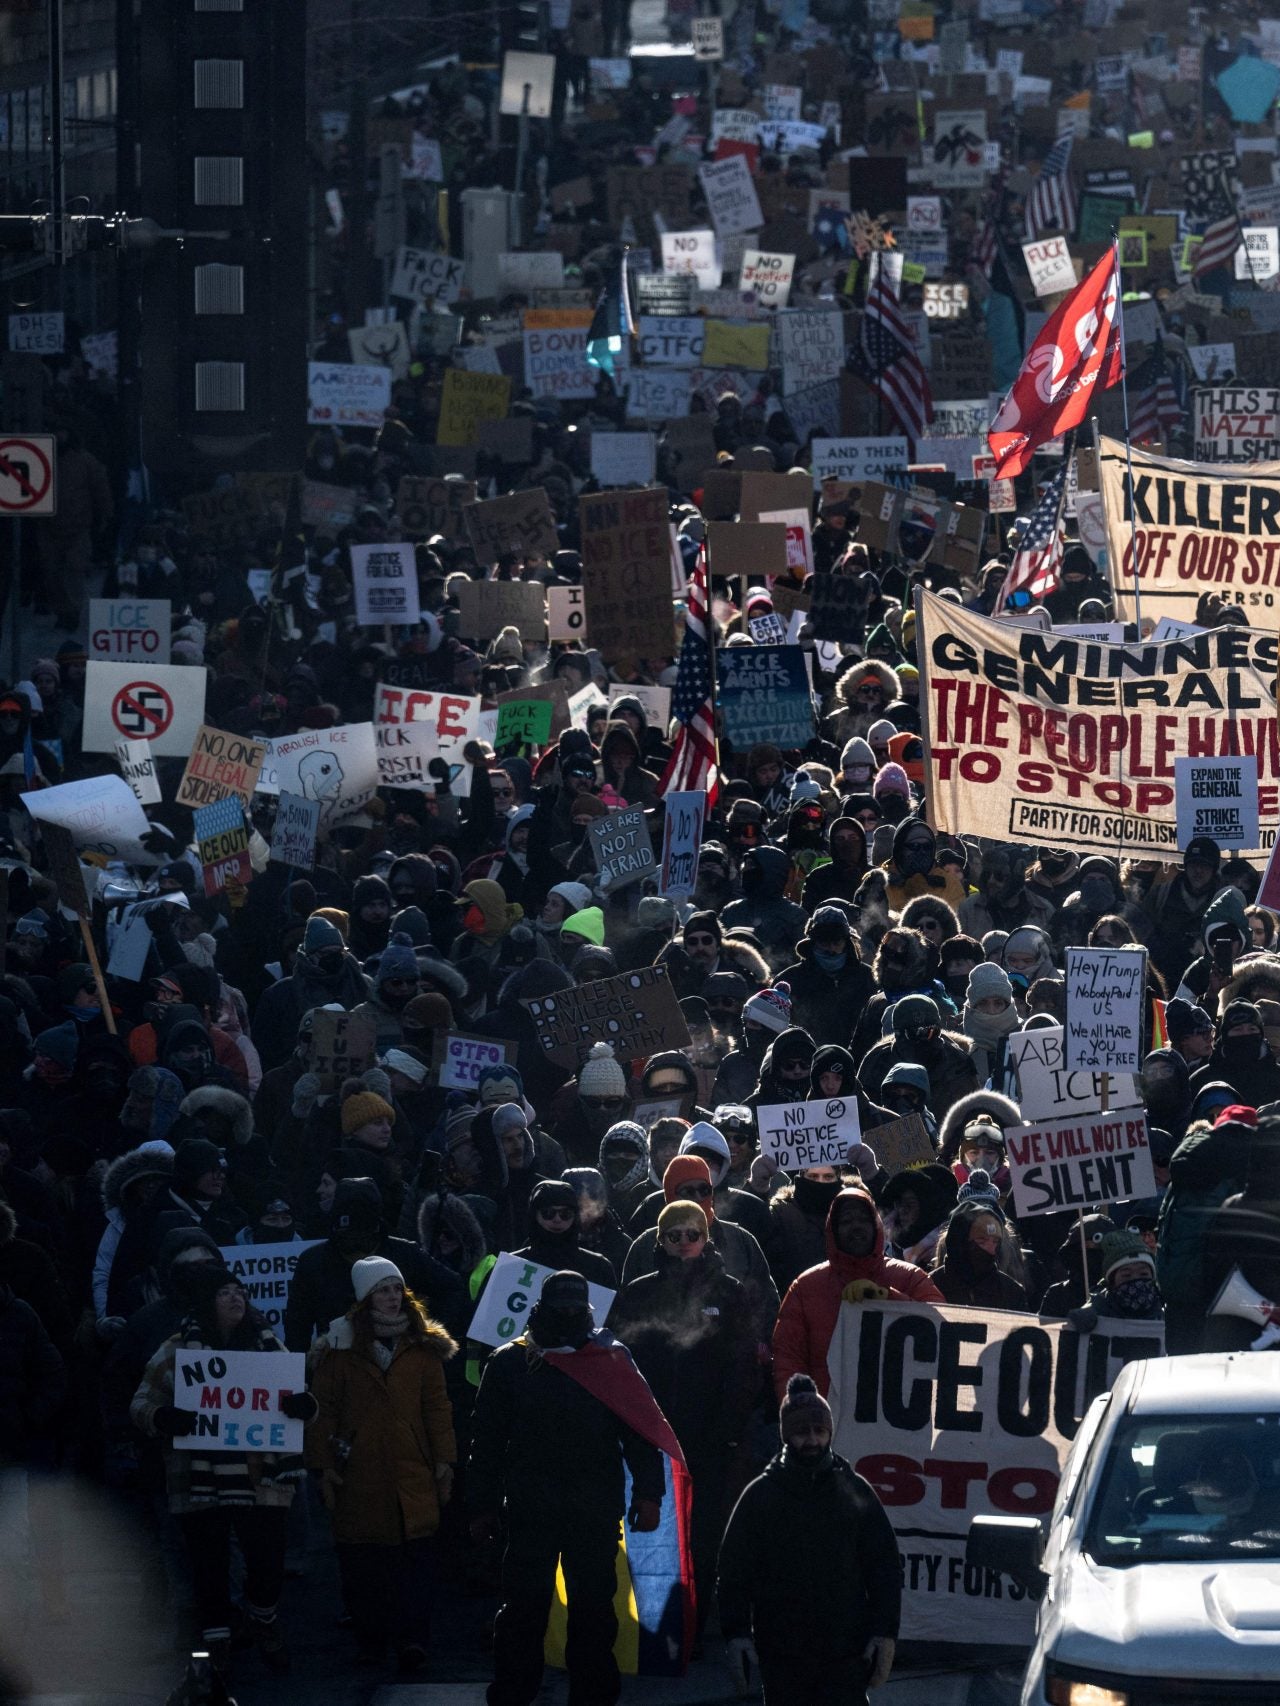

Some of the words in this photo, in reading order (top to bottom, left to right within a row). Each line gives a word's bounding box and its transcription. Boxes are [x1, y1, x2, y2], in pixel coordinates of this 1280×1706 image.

[674, 238, 698, 252] NO
[1027, 242, 1065, 264] FUCK
[757, 258, 782, 269] NO
[753, 282, 777, 295] NO
[927, 284, 963, 300] ICE
[923, 301, 961, 317] OUT
[657, 320, 692, 334] ICE
[1198, 390, 1260, 415] THIS
[1201, 415, 1274, 438] NAZI
[865, 446, 905, 458] THEN
[1122, 530, 1176, 578] OFF
[1180, 535, 1239, 584] OUR
[107, 605, 149, 627] ICE
[753, 618, 778, 629] ICE
[93, 630, 160, 653] GTFO
[741, 654, 781, 670] ICE
[932, 642, 1269, 710] GENERAL
[502, 707, 536, 719] FUCK
[931, 678, 1009, 749] THE
[1018, 703, 1178, 779] PEOPLE
[277, 733, 319, 757] ABOLISH
[330, 732, 347, 743] ICE
[190, 754, 249, 790] ILLEGAL
[931, 748, 1001, 784] TO
[1017, 761, 1176, 814] STOP
[1190, 768, 1223, 781] EXPAND
[1225, 767, 1241, 780] THE
[1191, 782, 1242, 798] GENERAL
[595, 822, 615, 837] WE
[617, 813, 641, 828] ARE
[1019, 806, 1068, 832] PARTY
[1070, 814, 1101, 836] FOR
[1196, 809, 1240, 825] STRIKE!
[220, 829, 247, 852] OUT
[602, 830, 638, 855] NOT
[601, 849, 654, 879] AFRAID
[1070, 956, 1100, 988] Hey
[1100, 955, 1140, 986] Trump
[449, 1040, 500, 1063] GTFO
[1105, 1053, 1135, 1065] FREE
[1052, 1069, 1119, 1104] ICE
[784, 1107, 805, 1127] NO
[766, 1124, 837, 1148] JUSTICE
[1008, 1136, 1041, 1166] WE
[1050, 1129, 1090, 1160] WILL
[1093, 1123, 1124, 1154] NOT
[1126, 1119, 1148, 1148] BE
[796, 1141, 848, 1163] PEACE
[1020, 1154, 1135, 1212] SILENT
[181, 1356, 228, 1387] NO
[853, 1310, 988, 1433] ICE
[223, 1423, 286, 1448] ICE
